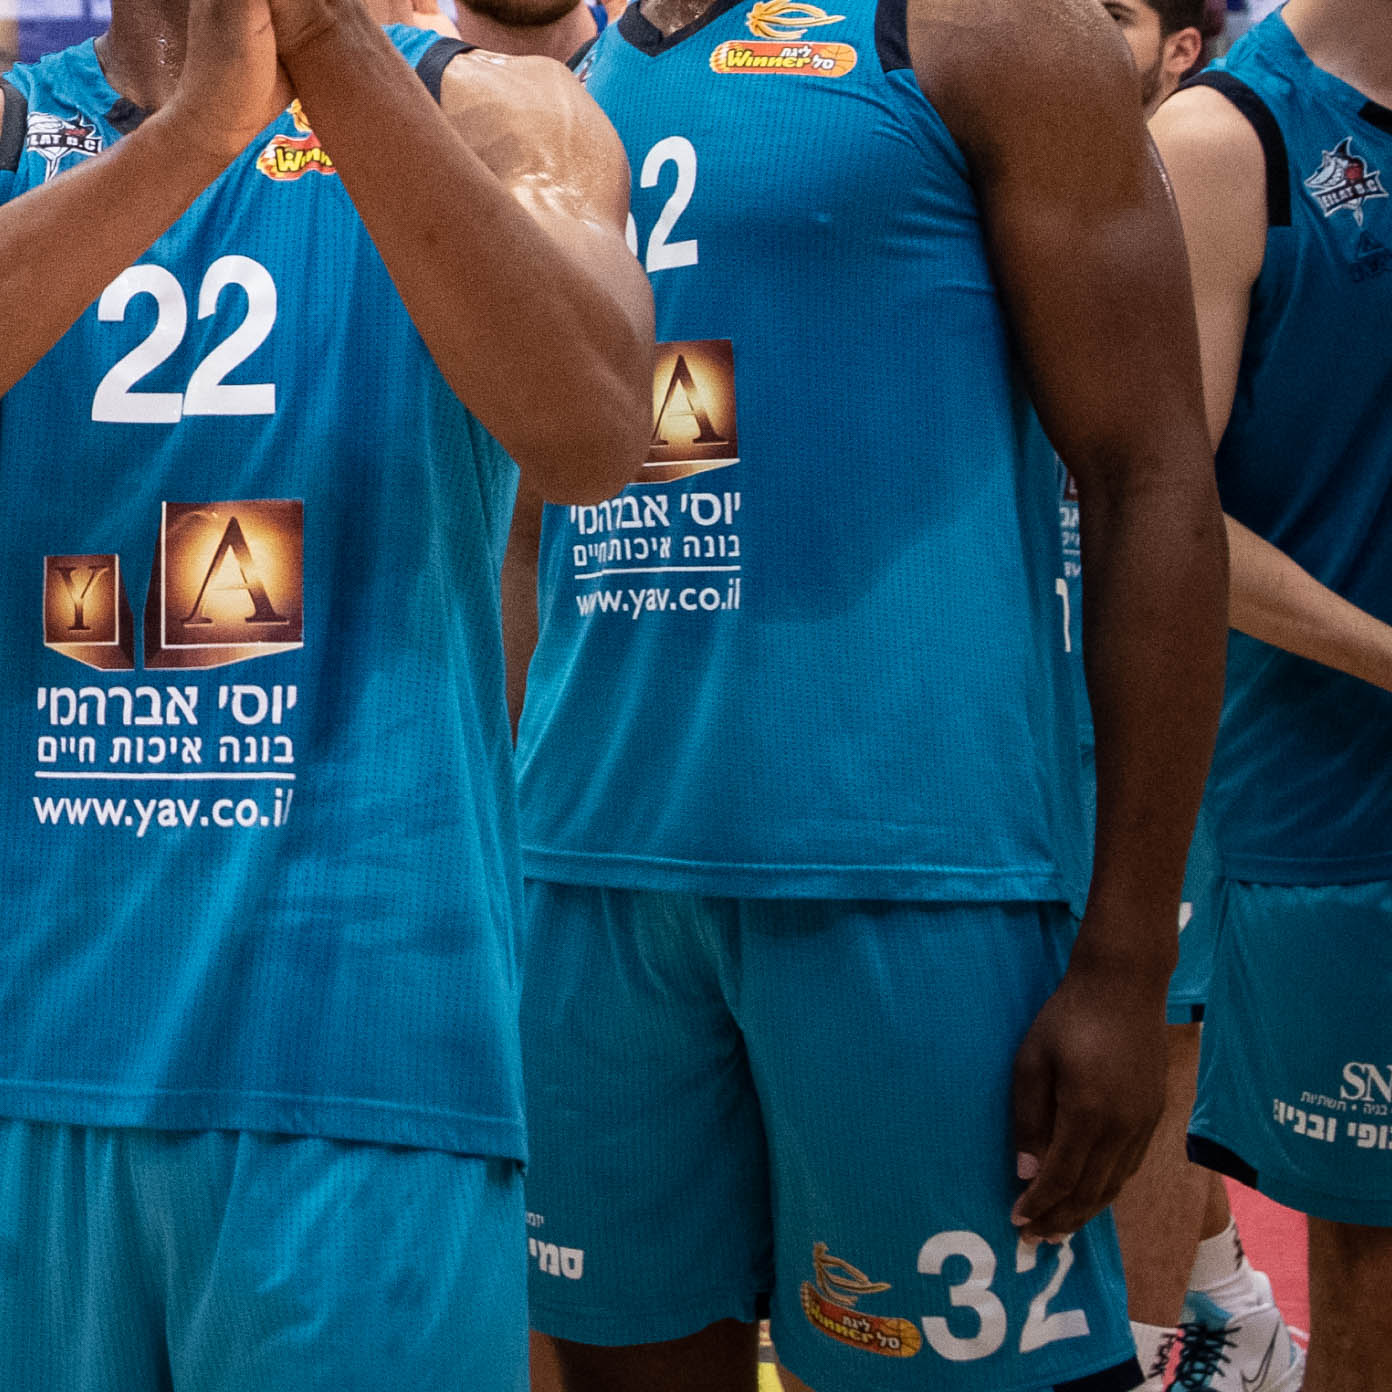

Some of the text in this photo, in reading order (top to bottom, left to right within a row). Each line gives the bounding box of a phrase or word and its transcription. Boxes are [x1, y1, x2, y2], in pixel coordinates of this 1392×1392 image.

[726, 48, 836, 71] Winner סל
[625, 136, 699, 274] 2
[92, 254, 278, 423] 22
[680, 492, 742, 527] יוסי
[608, 536, 672, 561] איכות
[683, 534, 742, 559] בונה
[37, 685, 298, 726] יוסי אברהמי
[37, 735, 295, 764] בונה איכות חיים
[32, 787, 294, 838] www.yav.co.il
[916, 1229, 1090, 1362] 32
